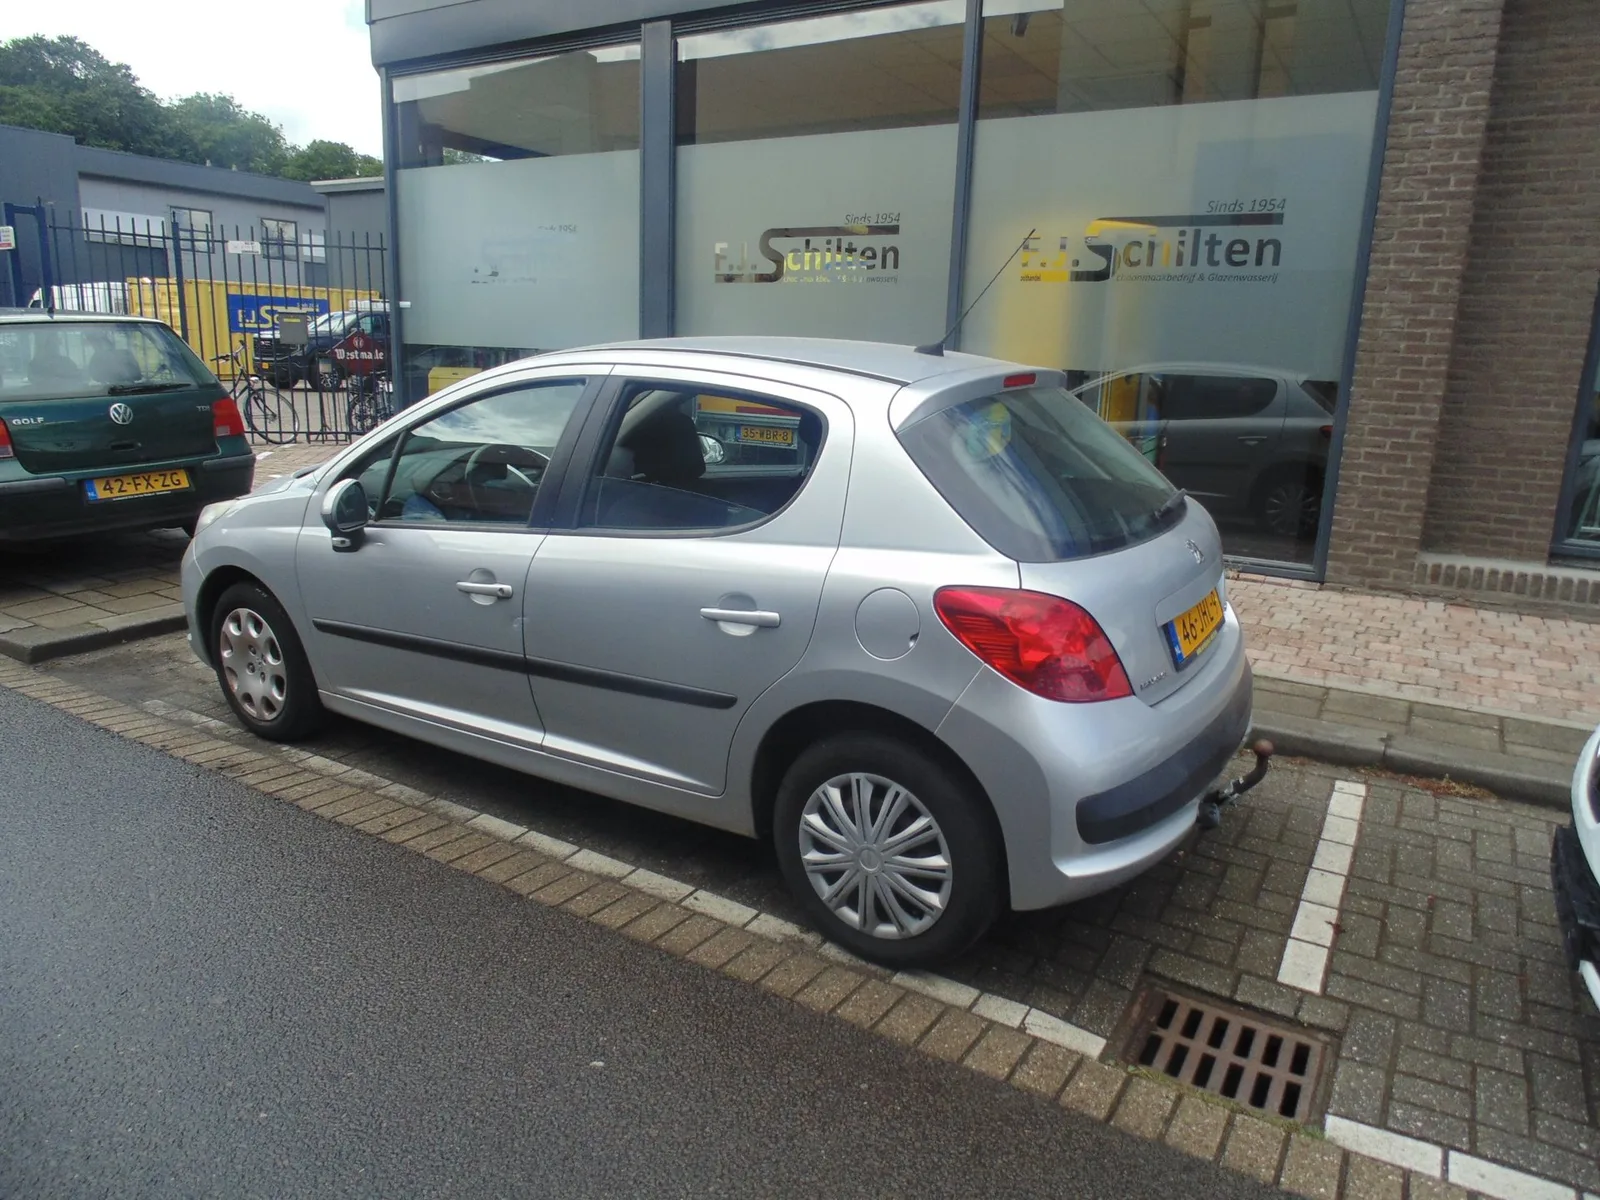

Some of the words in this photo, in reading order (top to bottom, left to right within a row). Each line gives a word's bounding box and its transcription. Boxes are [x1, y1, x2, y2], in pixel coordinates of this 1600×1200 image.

[1205, 198, 1244, 213] Sinds
[1248, 198, 1287, 212] 1954
[844, 212, 872, 225] Sinds
[874, 211, 901, 225] 1954
[1207, 272, 1279, 284] Glazenwasserij
[334, 348, 384, 360] Westmale
[12, 417, 44, 425] GOLF
[102, 472, 182, 494] 42-FX-ZG
